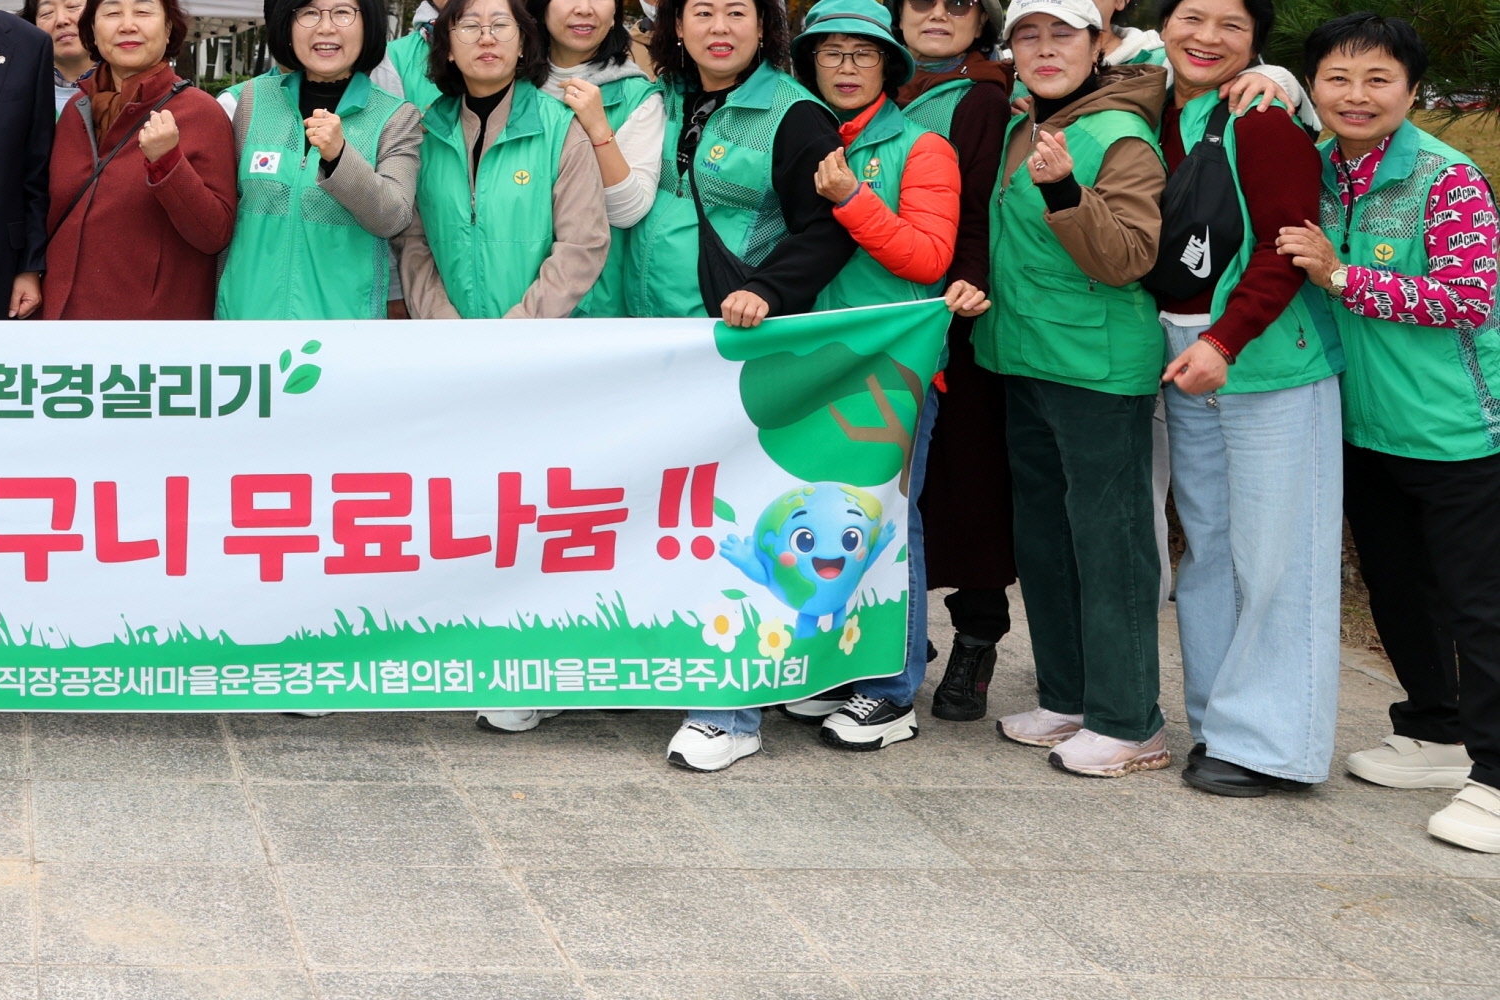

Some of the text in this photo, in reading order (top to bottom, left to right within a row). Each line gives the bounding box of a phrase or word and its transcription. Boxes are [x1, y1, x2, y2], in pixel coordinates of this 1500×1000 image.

[701, 160, 721, 173] SMU
[1448, 187, 1477, 204] MACAW
[1449, 233, 1480, 249] MACAW
[1179, 234, 1206, 270] NIKE
[223, 467, 628, 583] 무료나눔
